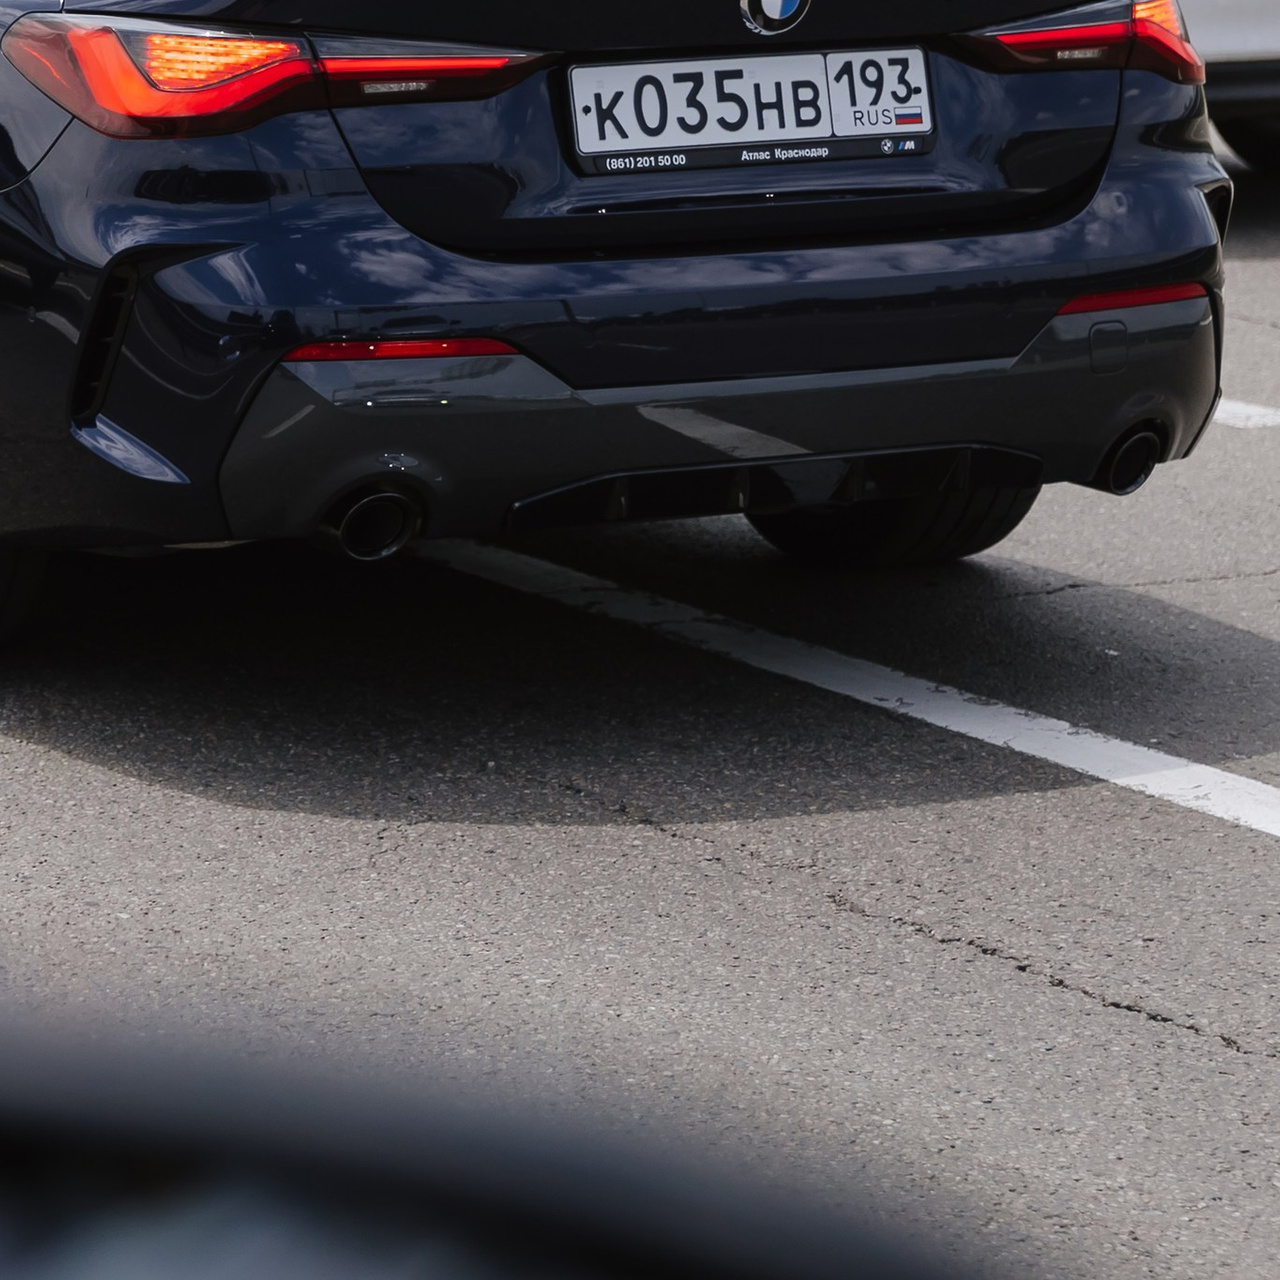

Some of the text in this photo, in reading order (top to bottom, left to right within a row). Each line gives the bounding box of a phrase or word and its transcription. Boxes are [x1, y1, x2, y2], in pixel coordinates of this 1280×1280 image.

[833, 57, 913, 108] 193
[853, 109, 893, 127] RUS
[606, 154, 686, 170] (861) 201 50 00
[740, 146, 829, 162] Атлас Краснодар
